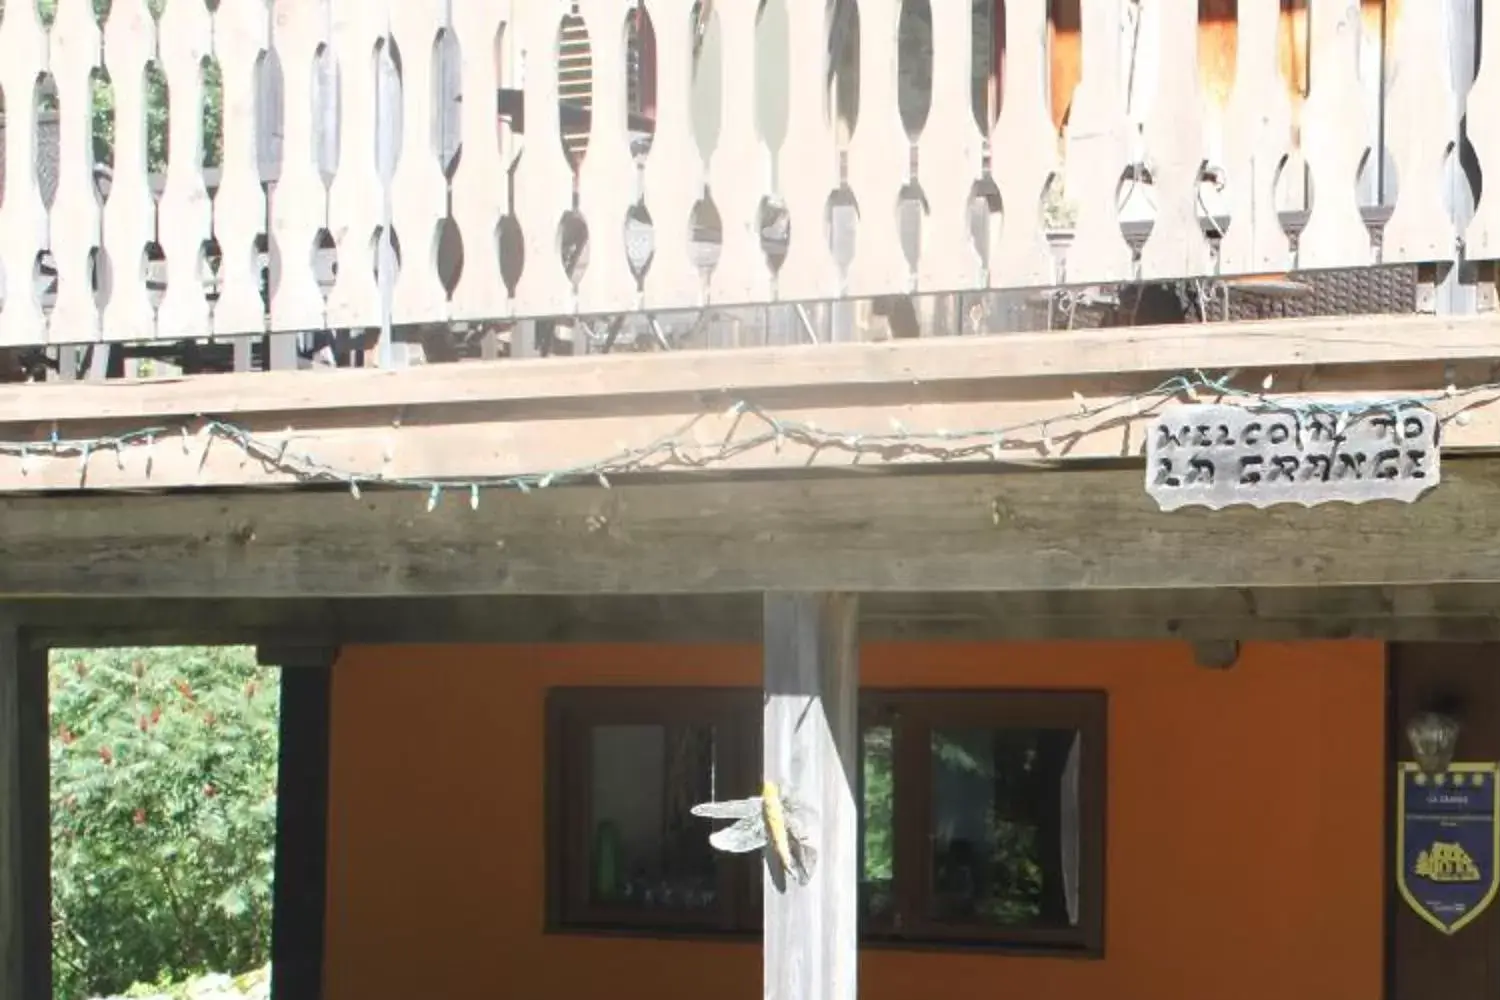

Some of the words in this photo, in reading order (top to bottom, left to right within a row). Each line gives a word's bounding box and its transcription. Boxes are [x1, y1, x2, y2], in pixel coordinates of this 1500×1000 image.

[1370, 416, 1425, 440] TO
[1154, 456, 1215, 487] LA
[1239, 449, 1427, 485] GRANGE
